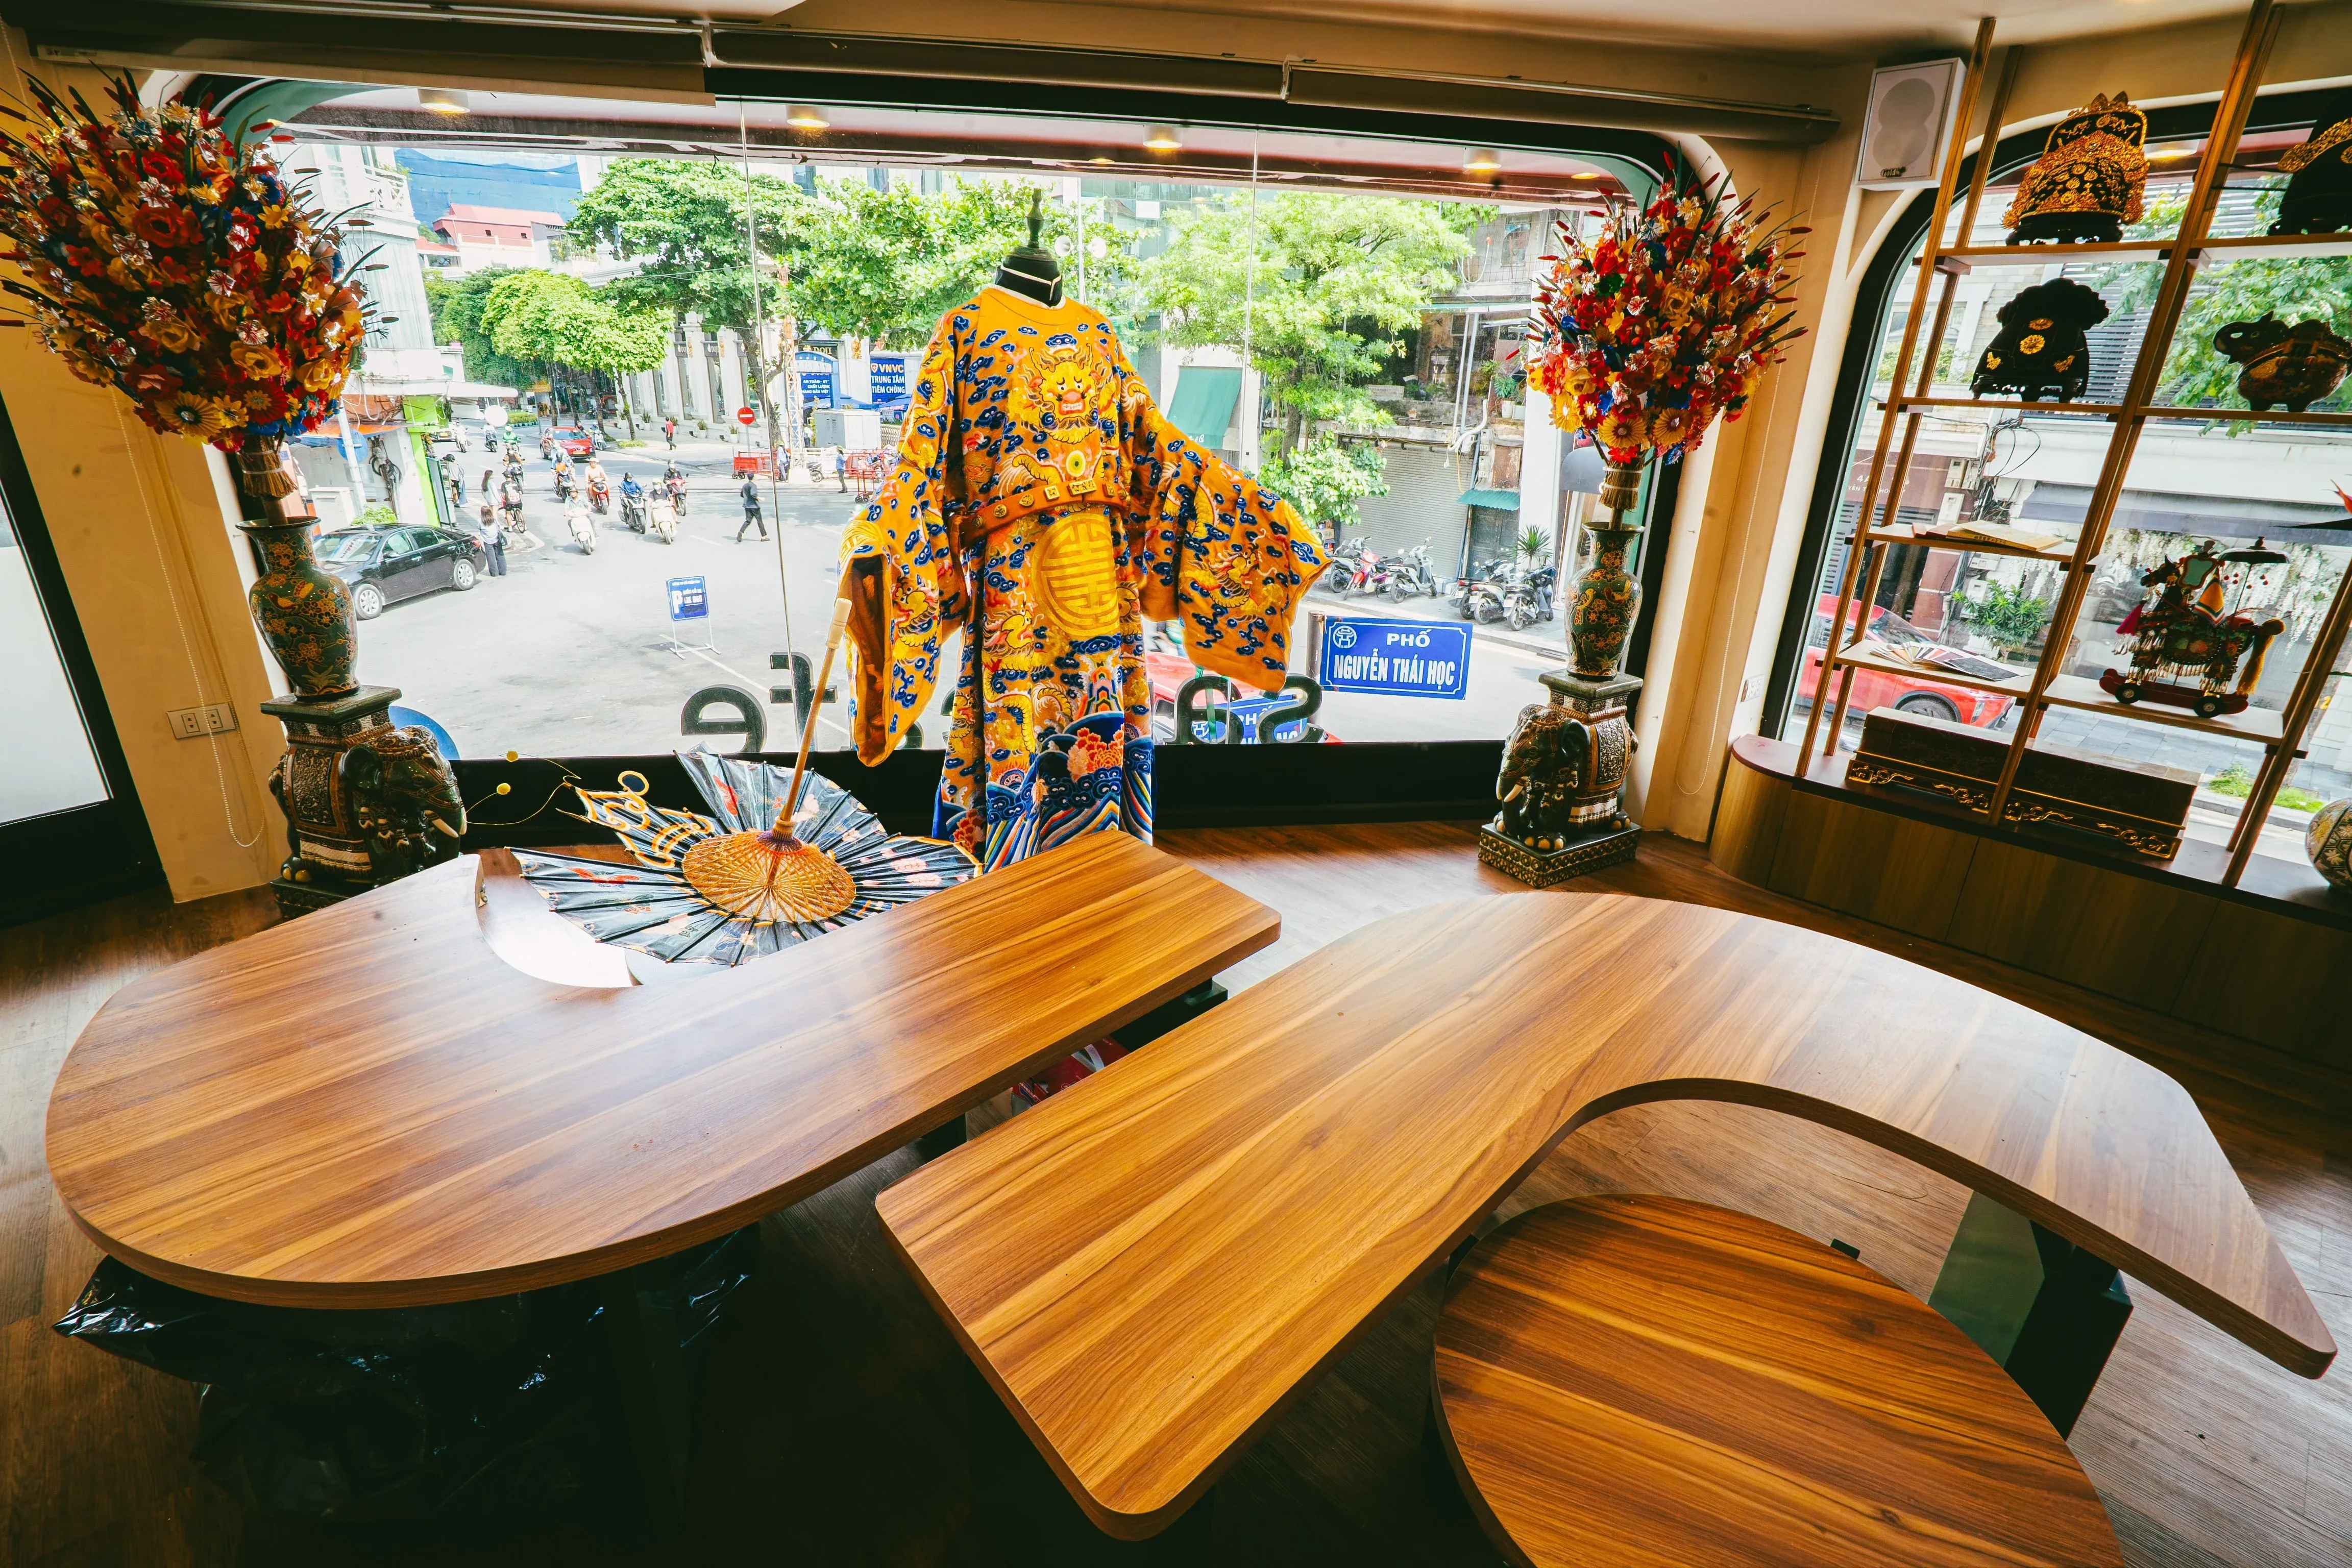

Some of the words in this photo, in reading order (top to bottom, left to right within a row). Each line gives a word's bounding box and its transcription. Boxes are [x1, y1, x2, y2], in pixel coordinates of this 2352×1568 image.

[879, 364, 904, 373] VNVC
[871, 375, 891, 383] TRUNG
[892, 374, 904, 383] TÂM
[871, 384, 885, 394] TIÊM
[671, 591, 683, 614] P
[1386, 629, 1432, 647] PHỐ
[1333, 648, 1389, 681] NGUYỄN
[1392, 654, 1424, 684] THÁI
[1427, 660, 1455, 690] HỌC
